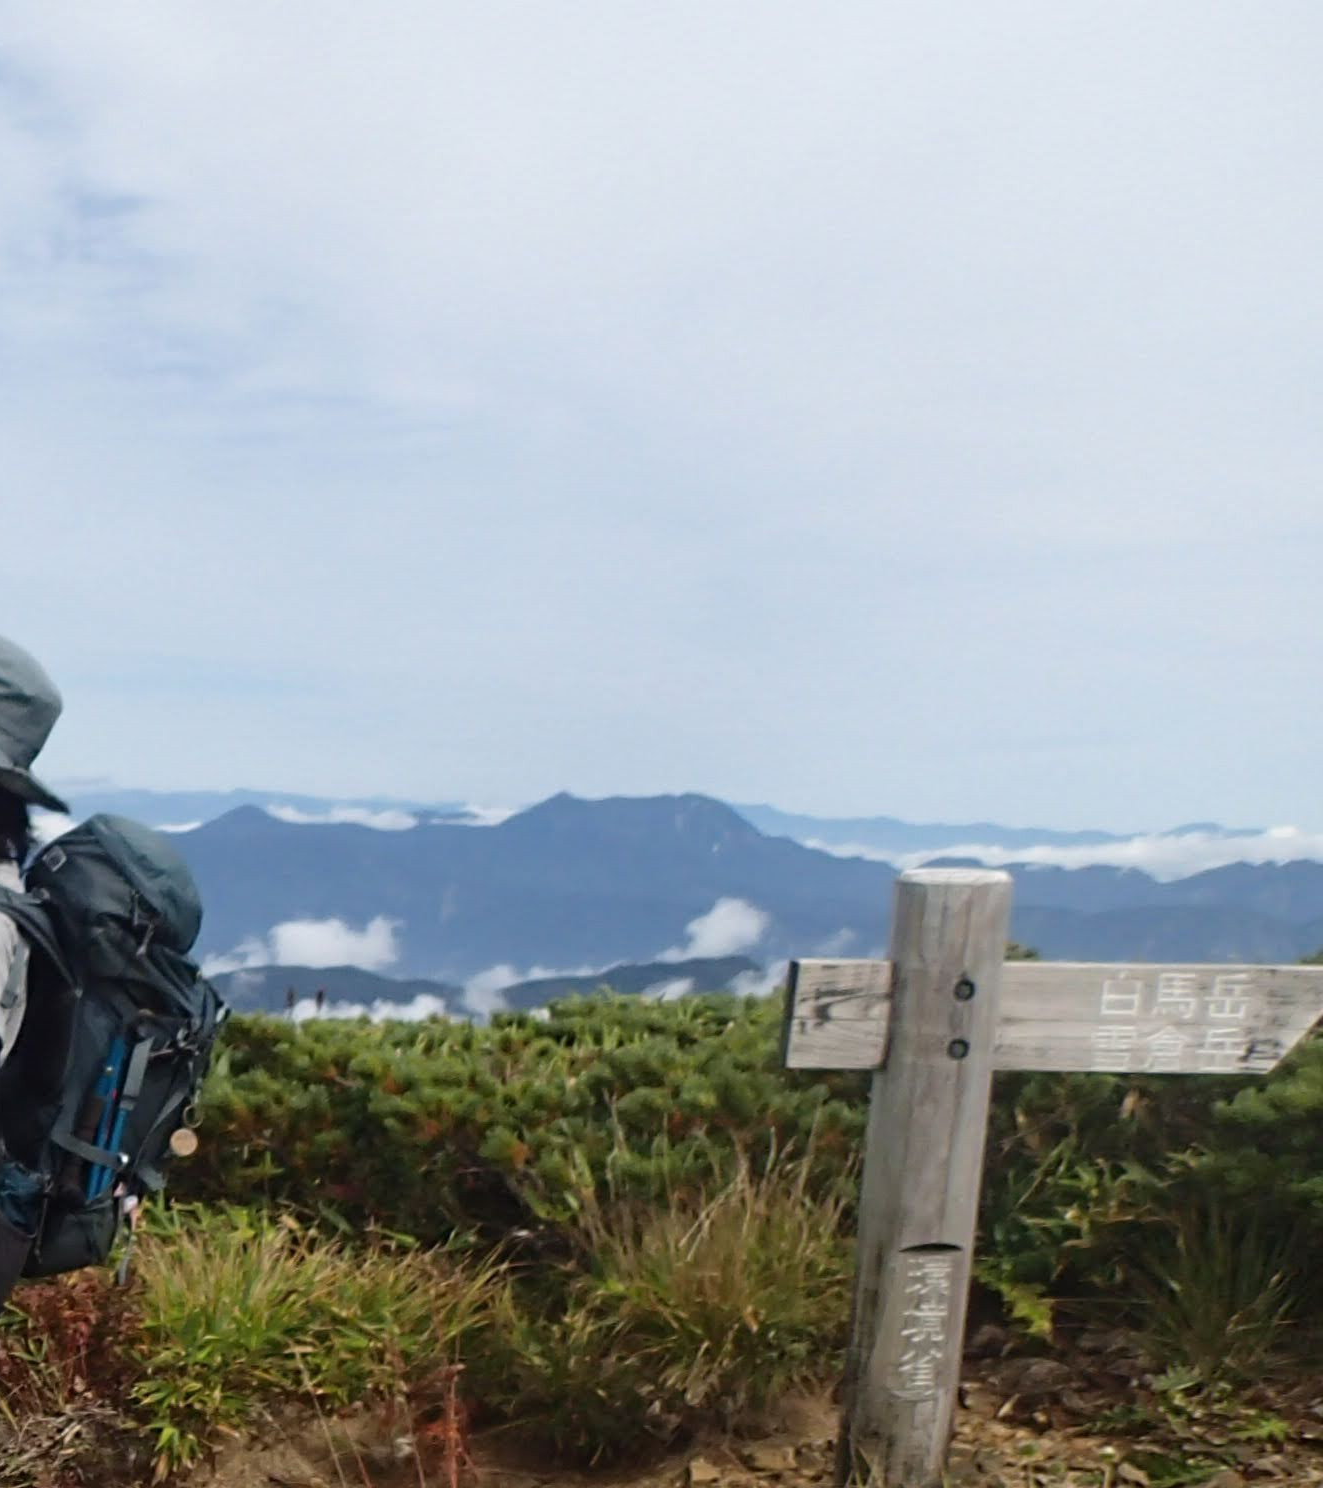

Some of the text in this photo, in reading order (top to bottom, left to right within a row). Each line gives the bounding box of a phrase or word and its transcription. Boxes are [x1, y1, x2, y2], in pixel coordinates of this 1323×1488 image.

[1100, 969, 1253, 1020] 白馬岳
[1091, 1025, 1246, 1073] 雪倉岳
[898, 1256, 953, 1387] 環境省
